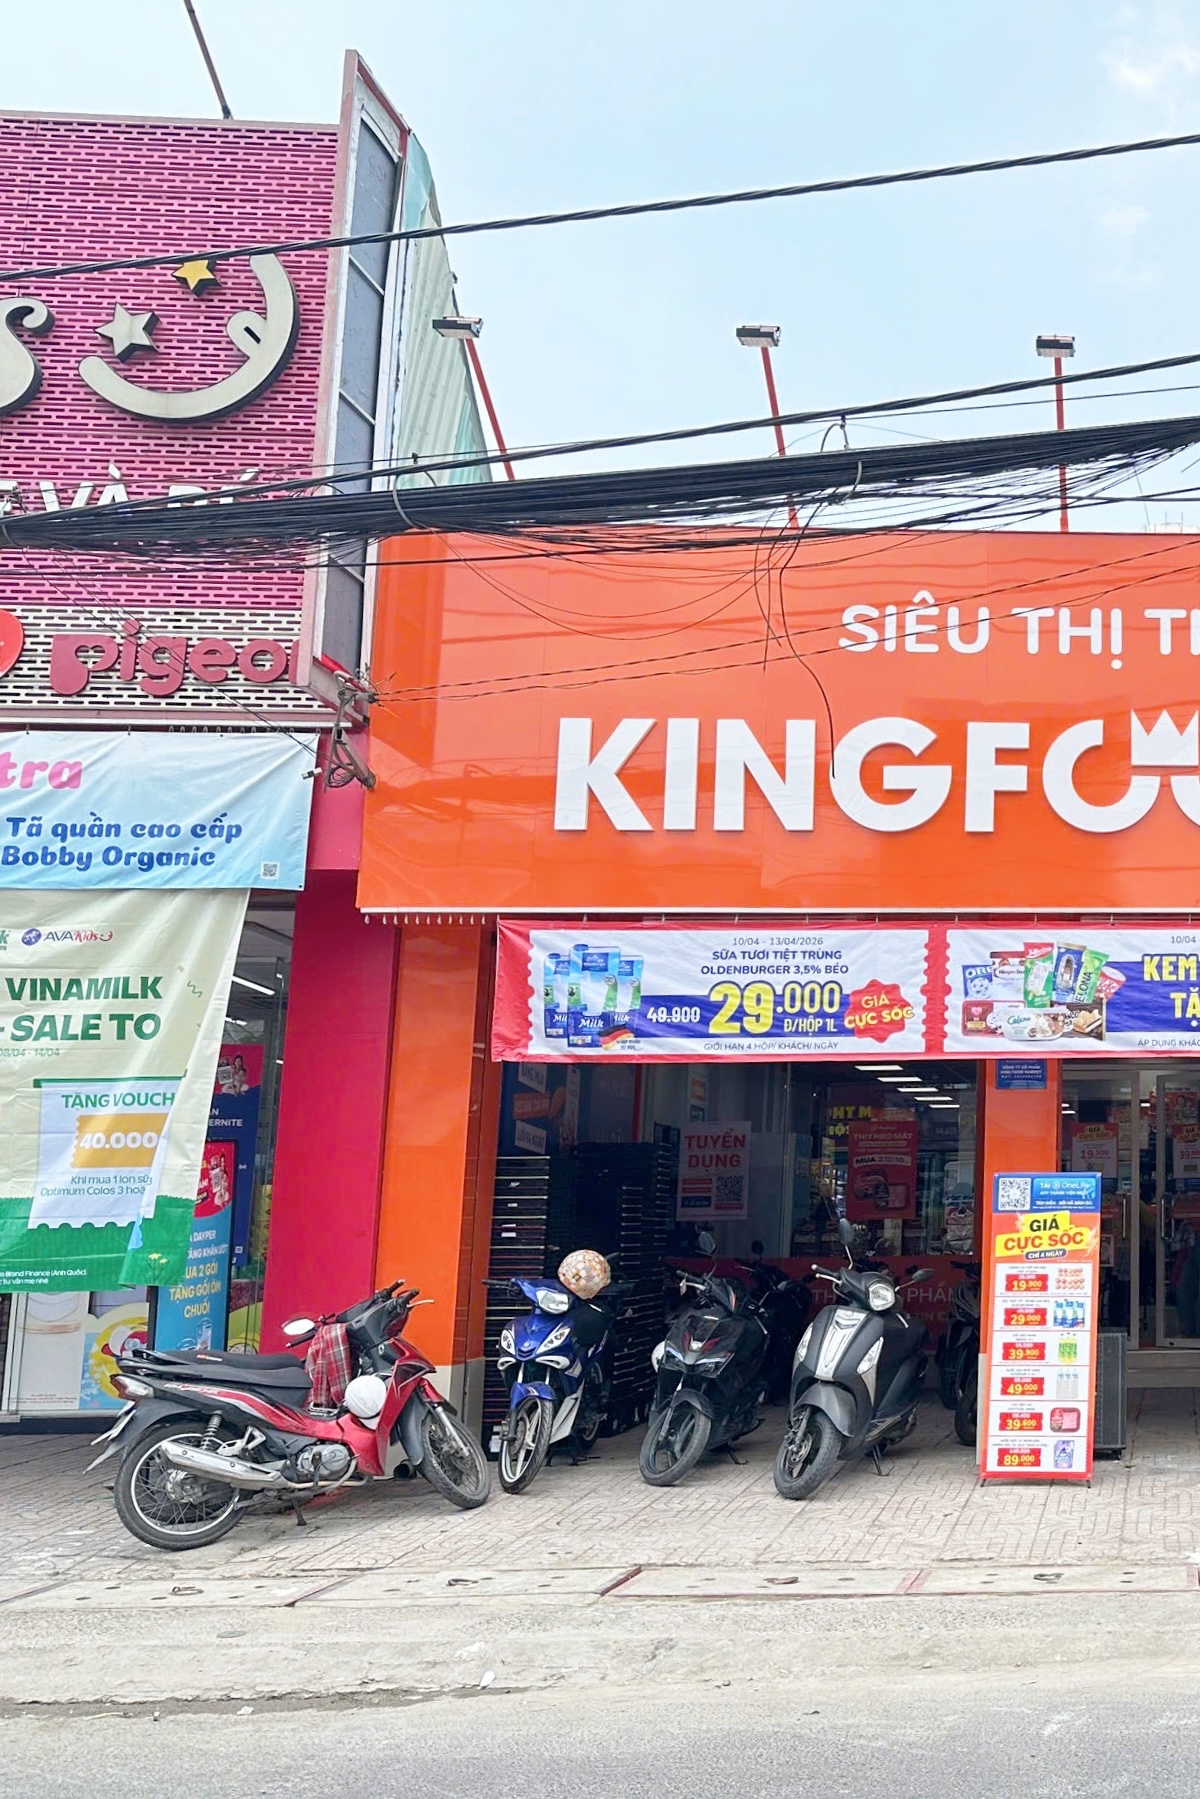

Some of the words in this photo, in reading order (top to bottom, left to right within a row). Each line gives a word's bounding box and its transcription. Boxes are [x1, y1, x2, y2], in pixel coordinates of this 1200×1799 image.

[838, 590, 989, 654] SIÊU
[1011, 606, 1123, 669] THỊ
[49, 617, 299, 697] pigeo
[6, 816, 43, 838] Tã
[51, 812, 121, 843] quần
[130, 822, 181, 838] cao
[190, 812, 243, 843] cấp
[1, 845, 92, 871] Bobby
[101, 846, 216, 872] Organic
[733, 937, 760, 946] 10/04
[770, 937, 823, 946] 13/04/2026
[712, 949, 737, 960] SỮA
[740, 949, 769, 960] TƯƠI
[774, 948, 797, 962] TIỆT
[801, 949, 842, 960] TRÙNG
[701, 965, 790, 975] OLDENBURGER
[794, 965, 821, 975] 3,5%
[825, 962, 849, 974] BÉO
[1143, 955, 1198, 982] KEM
[5, 976, 163, 1001] VINAMILK
[1074, 971, 1093, 1003] ELONA
[861, 990, 890, 1008] GIÁ
[844, 1011, 878, 1029] CỰC
[882, 1002, 915, 1022] SỐC
[10, 1013, 102, 1041] SALE
[109, 1013, 161, 1040] TO
[578, 1018, 604, 1028] Milk
[825, 1018, 838, 1032] 1L
[814, 1041, 838, 1049] NGÀY
[1137, 1038, 1150, 1046] ÁP
[34, 1048, 61, 1057] 14/04
[61, 1092, 111, 1110] TẶNG
[113, 1091, 175, 1108] VOUCH
[79, 1131, 159, 1150] 40.000
[685, 1128, 746, 1149] TUYỂN
[688, 1153, 742, 1172] DỤNG
[119, 1175, 136, 1184] lon
[40, 1187, 85, 1197] Optimum
[87, 1187, 115, 1195] Colos
[117, 1186, 124, 1194] 3
[1029, 1214, 1060, 1232] GIÁ
[1003, 1235, 1043, 1253] CỰC
[1048, 1227, 1084, 1247] SỐC
[198, 1265, 205, 1277] 2
[1012, 1280, 1042, 1291] 19.900
[1011, 1314, 1041, 1325] 29.000
[1009, 1348, 1039, 1359] 39.900
[1007, 1384, 1038, 1394] 49.000
[1006, 1419, 1036, 1429] 39.600
[1004, 1454, 1035, 1465] 89.000
